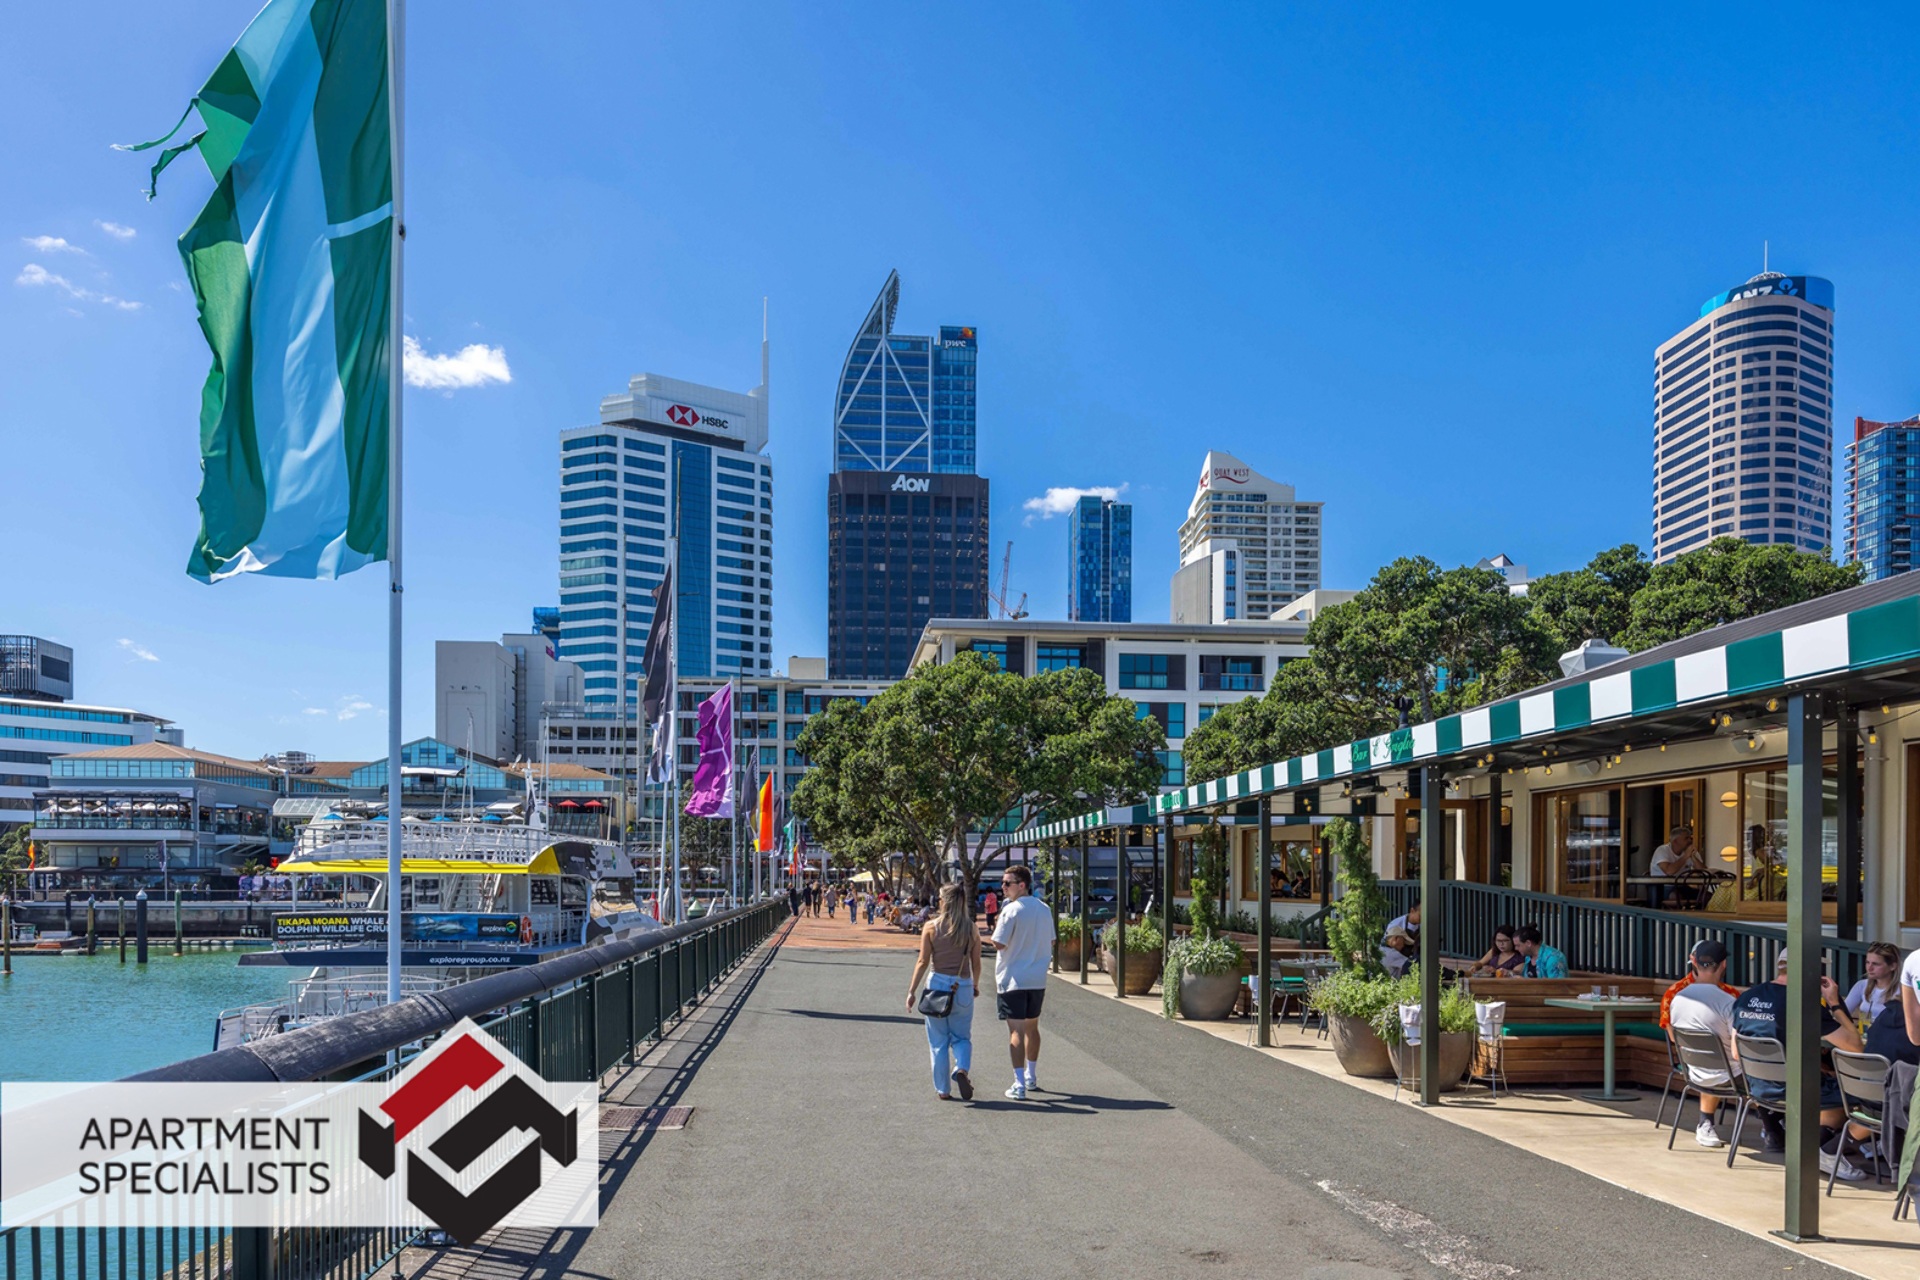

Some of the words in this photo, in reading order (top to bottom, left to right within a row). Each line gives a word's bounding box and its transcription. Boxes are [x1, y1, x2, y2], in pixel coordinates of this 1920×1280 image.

[945, 339, 966, 348] pwc
[702, 416, 729, 429] HSBC
[1233, 468, 1249, 477] WEST
[891, 474, 930, 492] AON
[313, 917, 349, 925] MOANA
[351, 917, 384, 925] WHALE
[278, 925, 320, 934] DOLPHIN
[322, 925, 364, 933] WILDLIFE
[482, 925, 506, 933] explore
[429, 956, 510, 965] exploregroup.co.nz
